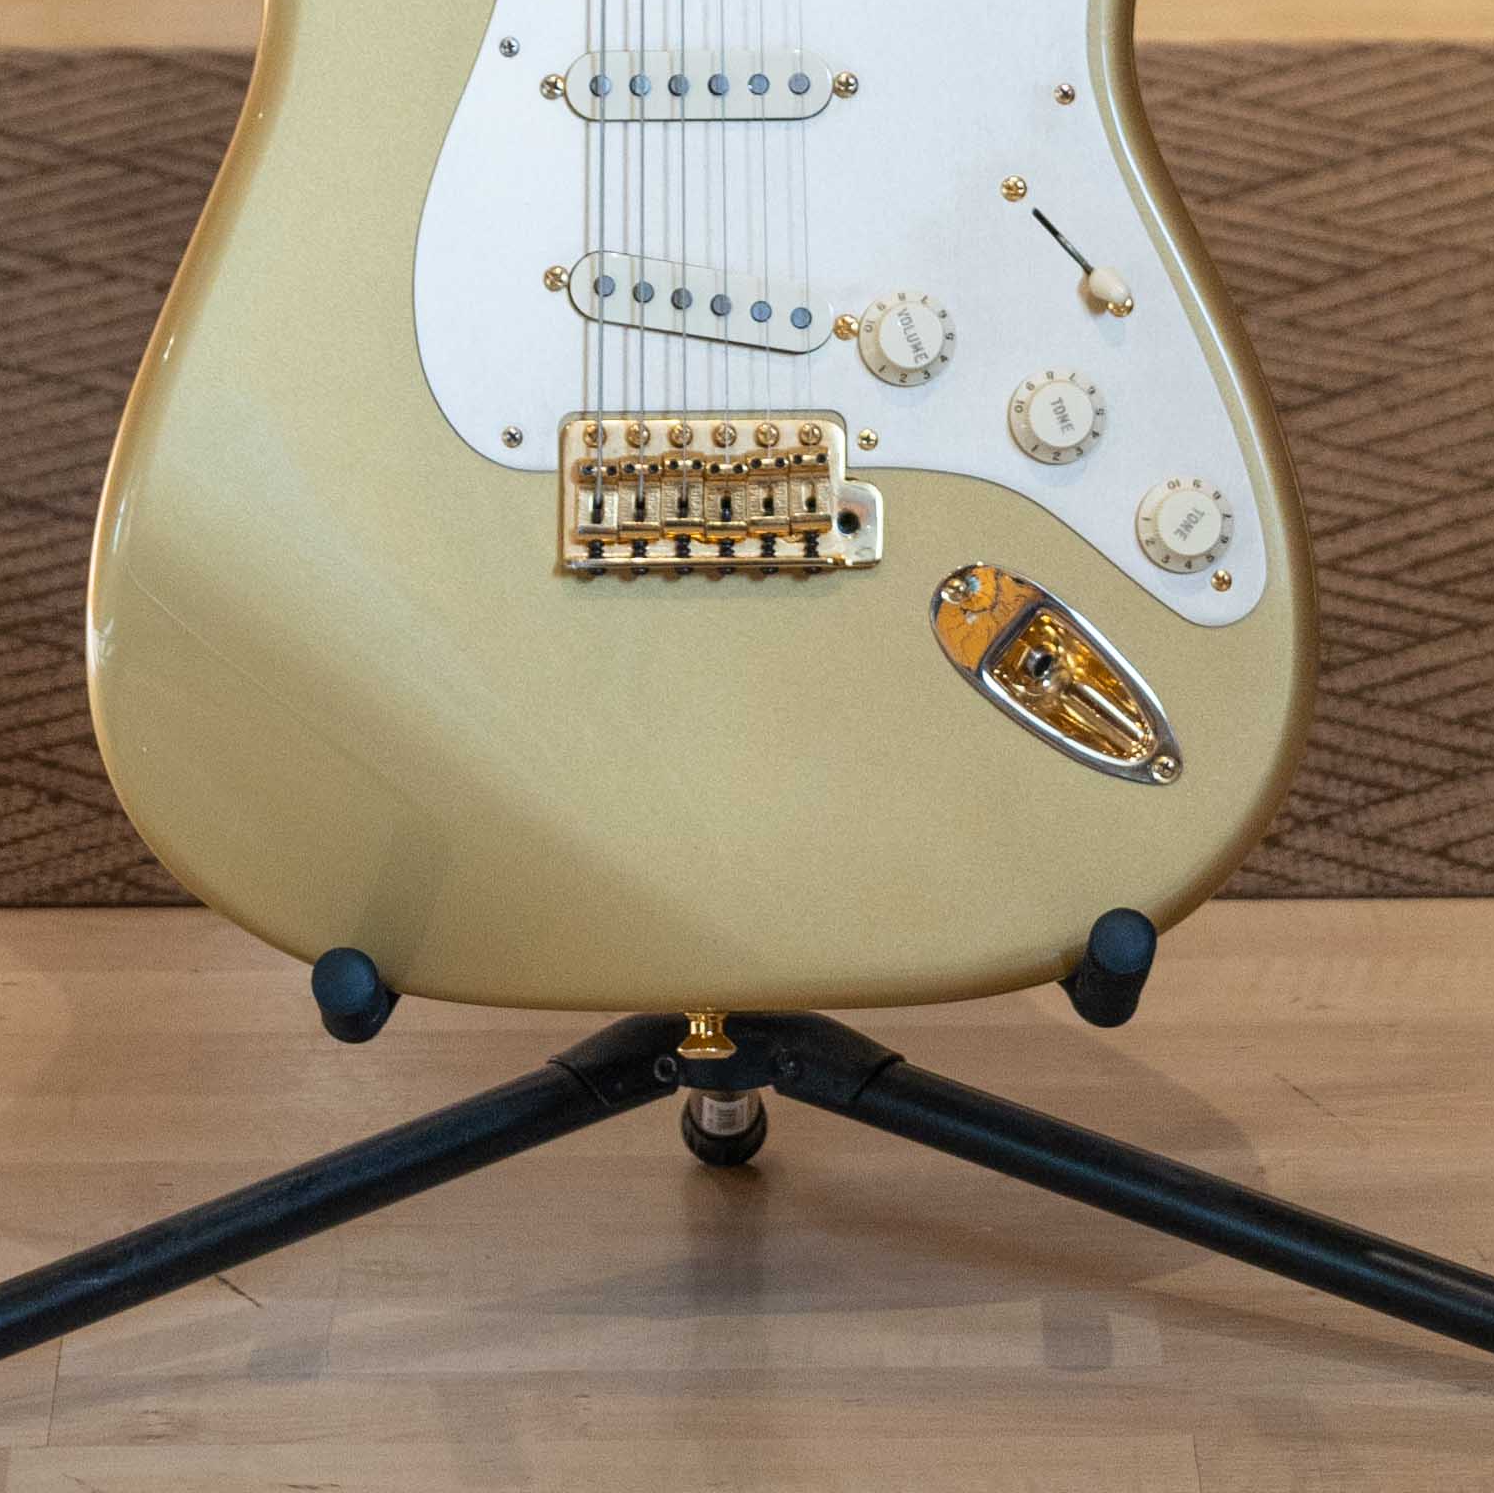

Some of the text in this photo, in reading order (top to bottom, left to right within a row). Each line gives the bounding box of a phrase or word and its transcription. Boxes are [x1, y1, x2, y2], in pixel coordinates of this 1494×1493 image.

[897, 307, 929, 364] VOLUME
[1050, 396, 1075, 434] TONE
[1173, 506, 1205, 542] TONE
